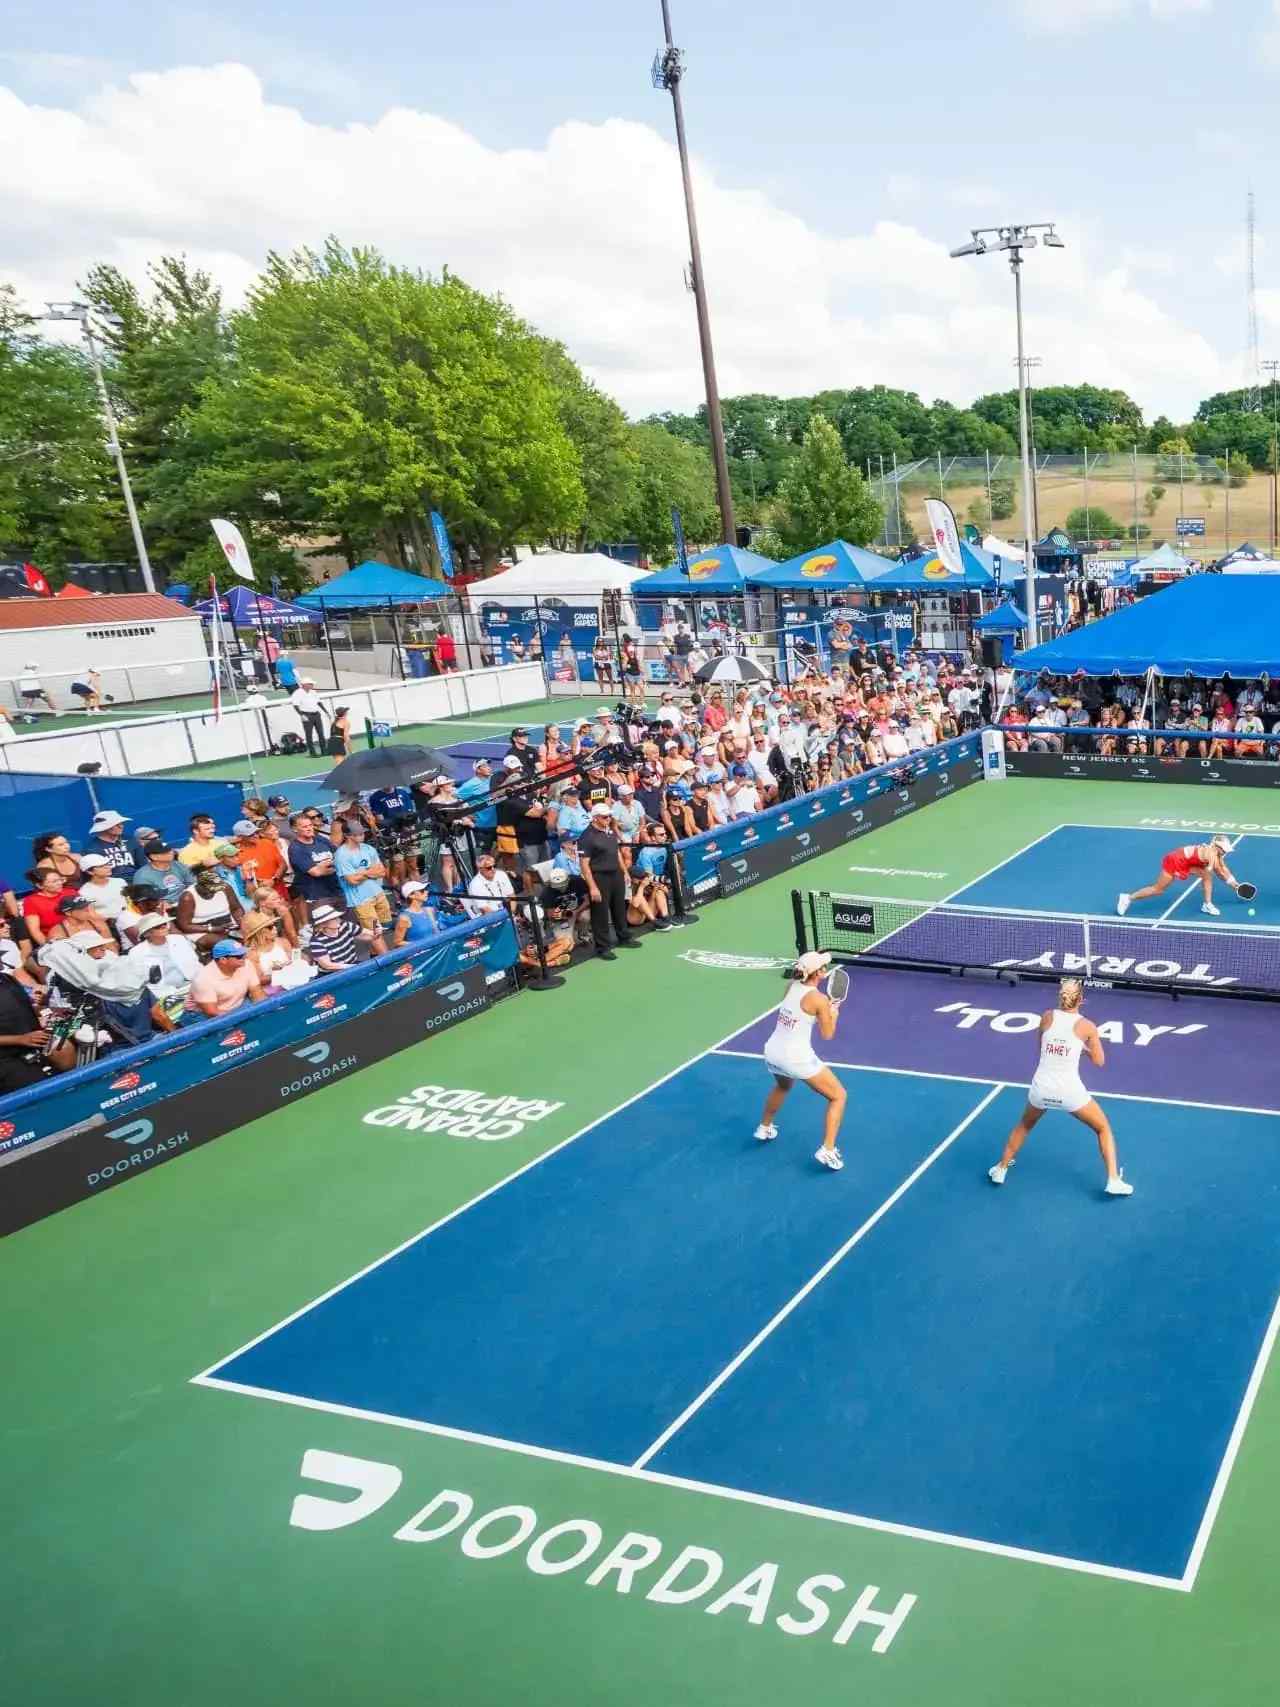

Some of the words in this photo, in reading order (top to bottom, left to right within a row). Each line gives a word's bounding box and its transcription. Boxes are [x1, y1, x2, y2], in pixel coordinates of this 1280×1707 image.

[425, 995, 487, 1030] DOORDASH
[280, 1055, 358, 1097] DOORDASH
[100, 1096, 120, 1110] BEER
[120, 1090, 138, 1101] CITY
[138, 1081, 158, 1094] OPEN
[397, 1085, 566, 1122] RAPIDS
[13, 1130, 36, 1146] OPEN
[362, 1104, 525, 1142] GRAND
[87, 1131, 190, 1186] DOORDASH
[393, 1488, 918, 1654] DOORDASH
